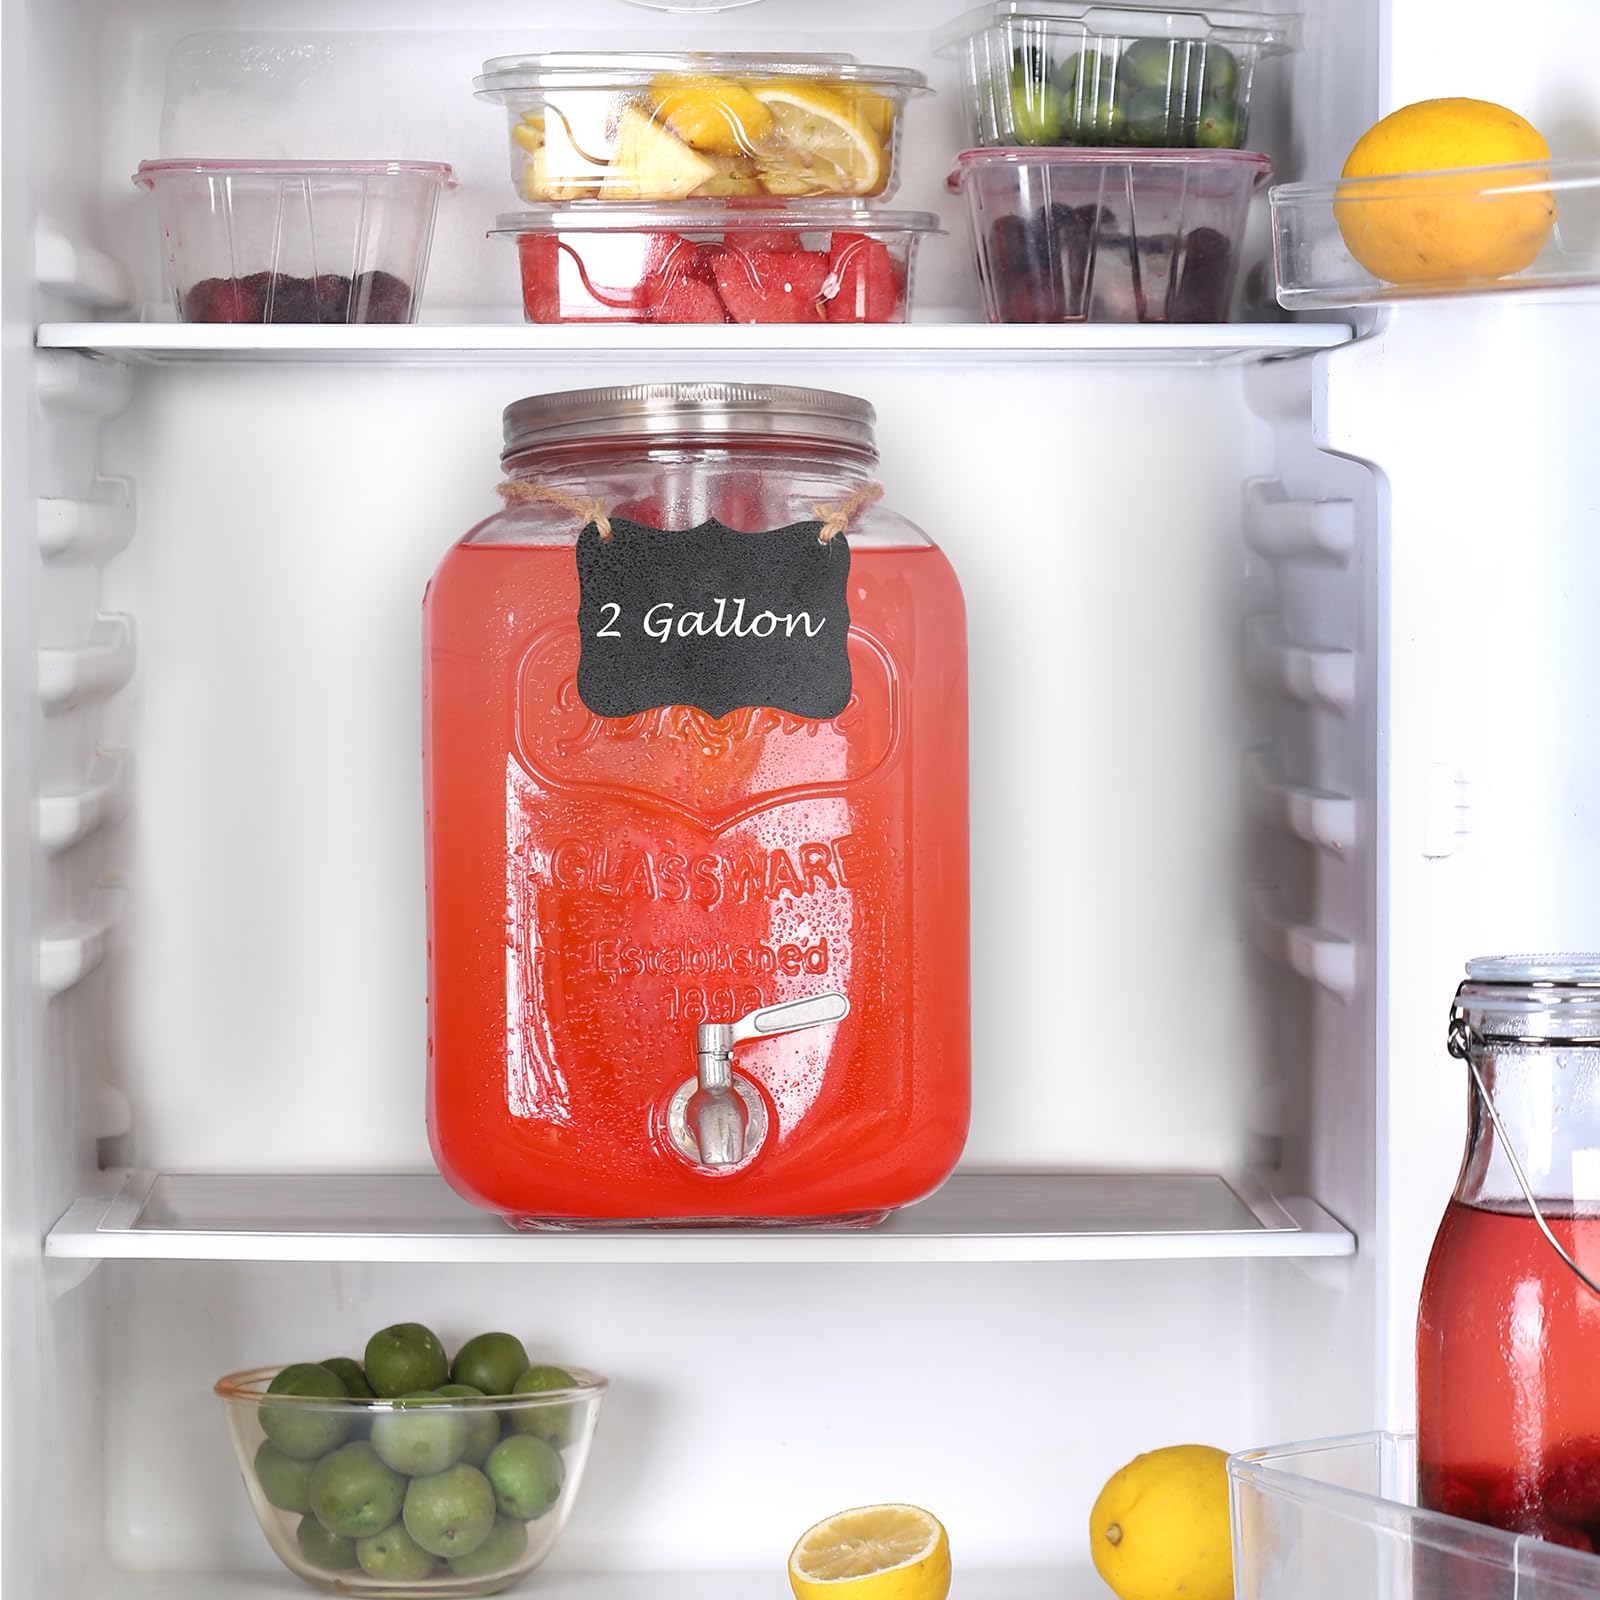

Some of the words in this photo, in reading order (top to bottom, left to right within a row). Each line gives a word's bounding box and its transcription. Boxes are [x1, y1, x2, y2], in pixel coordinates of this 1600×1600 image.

[596, 602, 622, 638] 2
[643, 597, 827, 643] Gallon
[551, 836, 868, 911] GLASSWARE
[594, 937, 829, 977] Established
